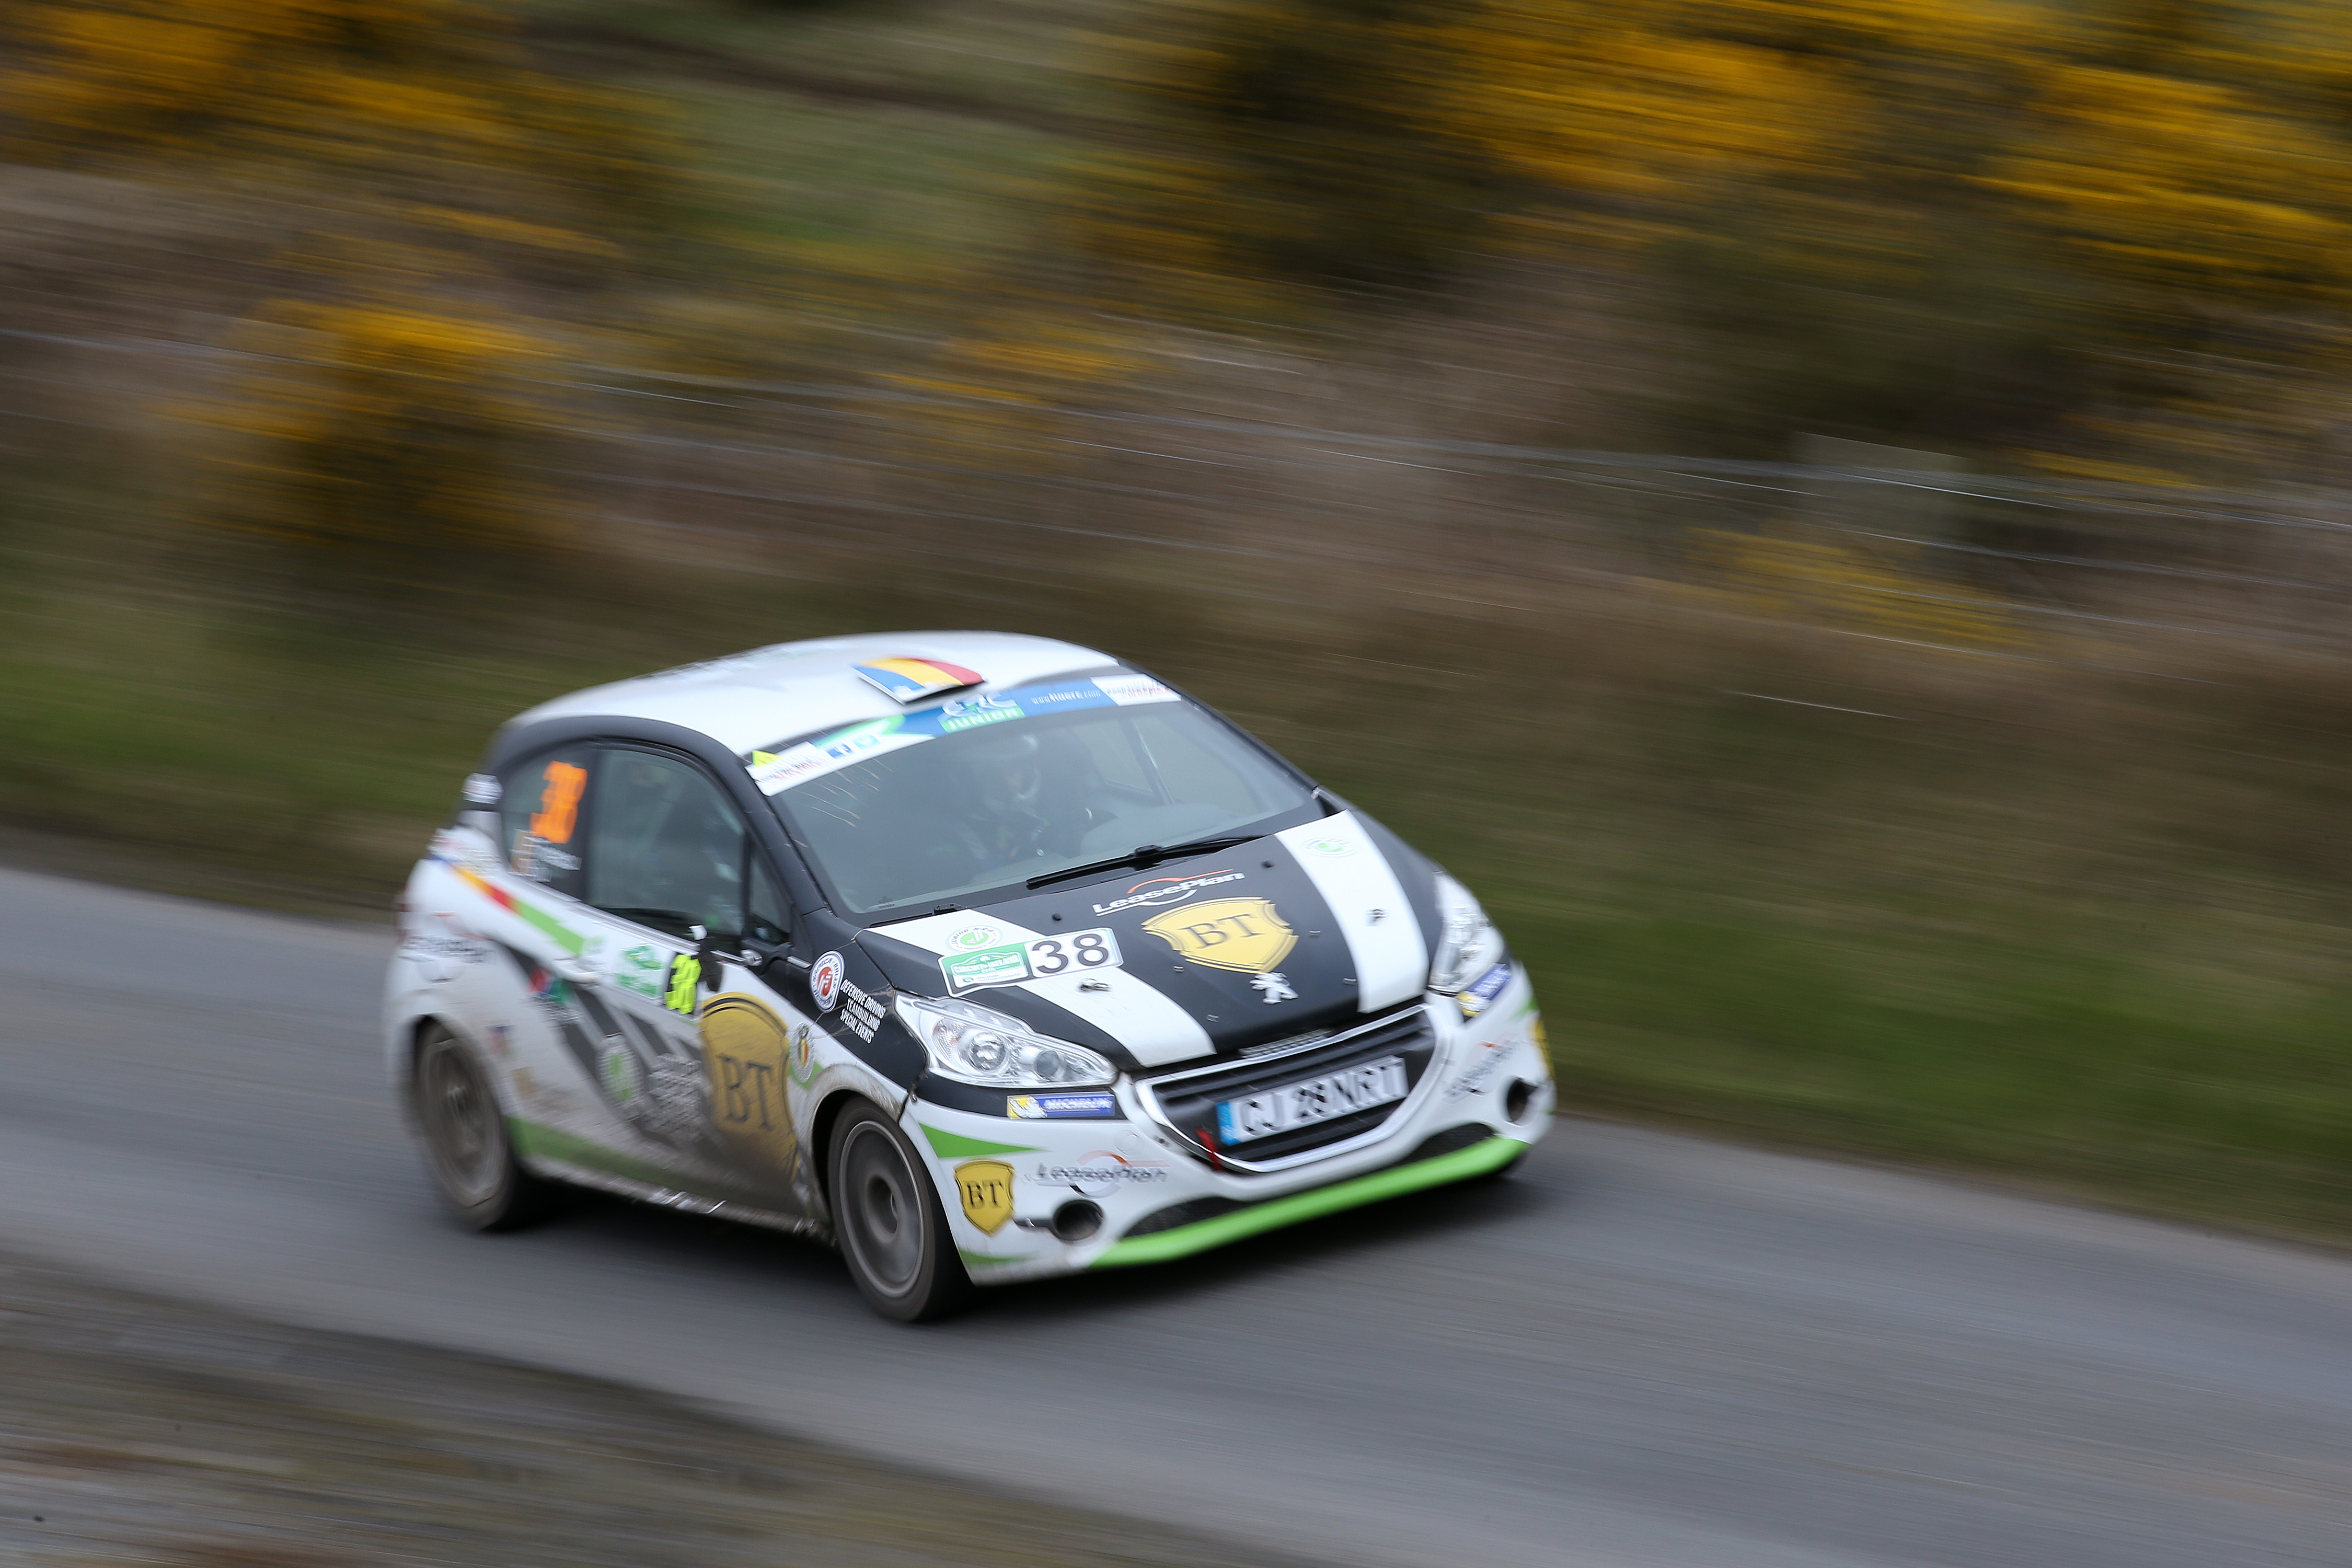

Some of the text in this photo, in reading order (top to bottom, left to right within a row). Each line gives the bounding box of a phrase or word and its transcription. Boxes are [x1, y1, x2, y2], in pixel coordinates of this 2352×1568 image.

[947, 708, 1020, 731] JUNIOR
[1092, 872, 1246, 914] LeasePlan
[1178, 913, 1265, 949] BT
[1032, 933, 1109, 974] 38
[840, 978, 867, 1006] DEFENSIVE
[864, 996, 886, 1019] DRIVING
[847, 998, 881, 1032] TEAMBUILDING
[840, 1008, 874, 1044] SPECIAL EVENTS
[717, 1052, 775, 1132] BT
[967, 1180, 1005, 1209] BT
